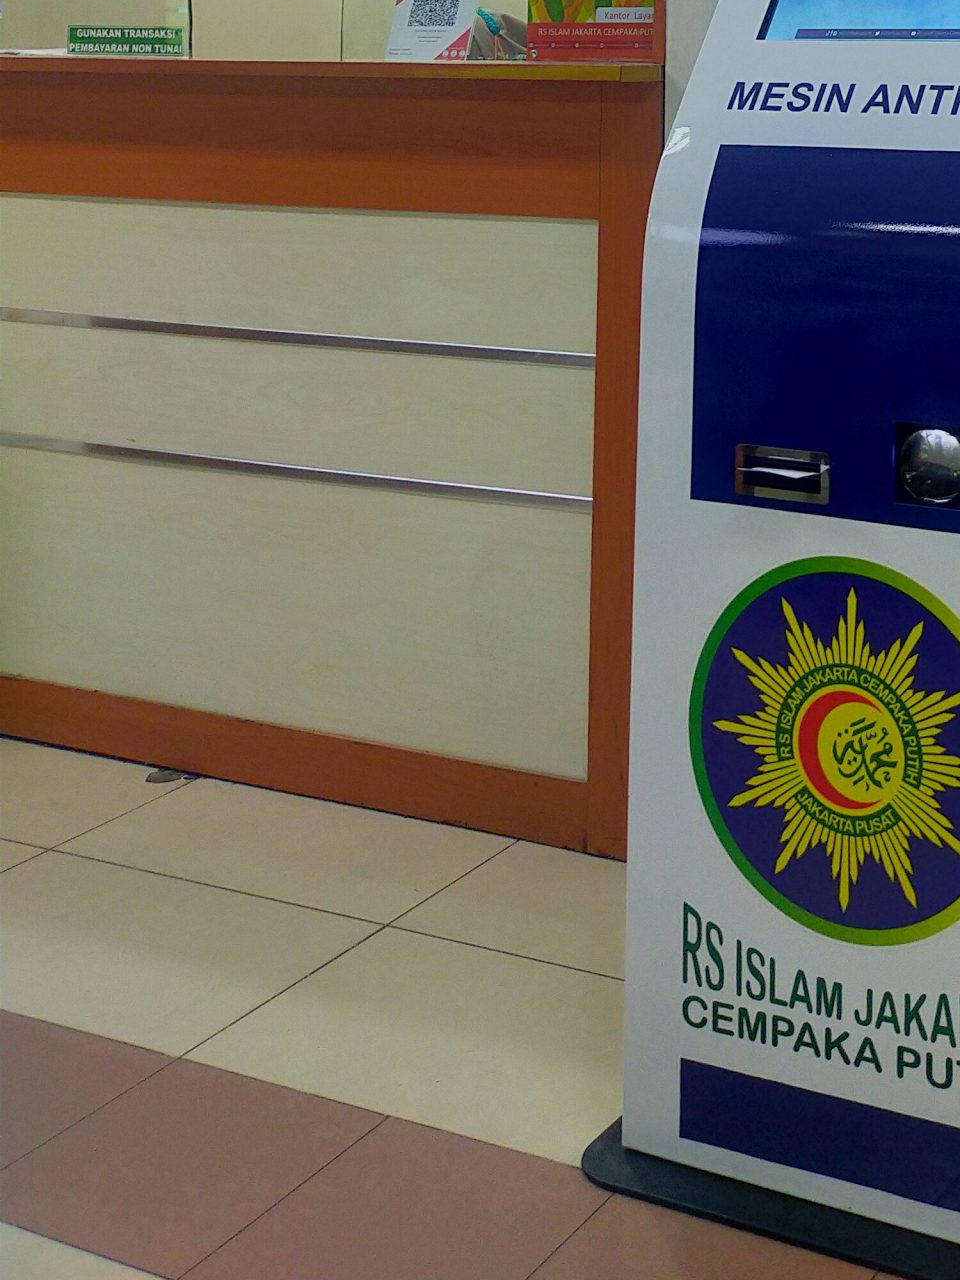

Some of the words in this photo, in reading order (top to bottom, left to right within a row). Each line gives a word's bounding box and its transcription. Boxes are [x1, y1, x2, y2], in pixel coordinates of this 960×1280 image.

[538, 28, 547, 36] RS
[548, 28, 571, 36] ISLAM
[571, 28, 602, 36] JAKARTA
[603, 27, 638, 36] CEMPAKA
[604, 11, 630, 20] Kantor
[69, 43, 129, 53] PEMBAYARAN
[131, 44, 152, 53] NON
[154, 44, 182, 54] TUNAI
[76, 28, 122, 38] GUNAKAN
[123, 29, 176, 39] TRANSAKSI
[726, 81, 856, 113] MESIN
[802, 665, 860, 691] JAKARTA
[781, 687, 804, 727] ISLAM
[860, 672, 911, 735] CEMPAKA
[779, 733, 793, 760] RS
[904, 735, 922, 785] PUTIH
[797, 791, 854, 834] JAKARTA
[855, 809, 897, 834] PUSAT
[682, 901, 724, 992] RS
[736, 939, 843, 1022] ISLAM
[682, 996, 882, 1074] CEMPAKA
